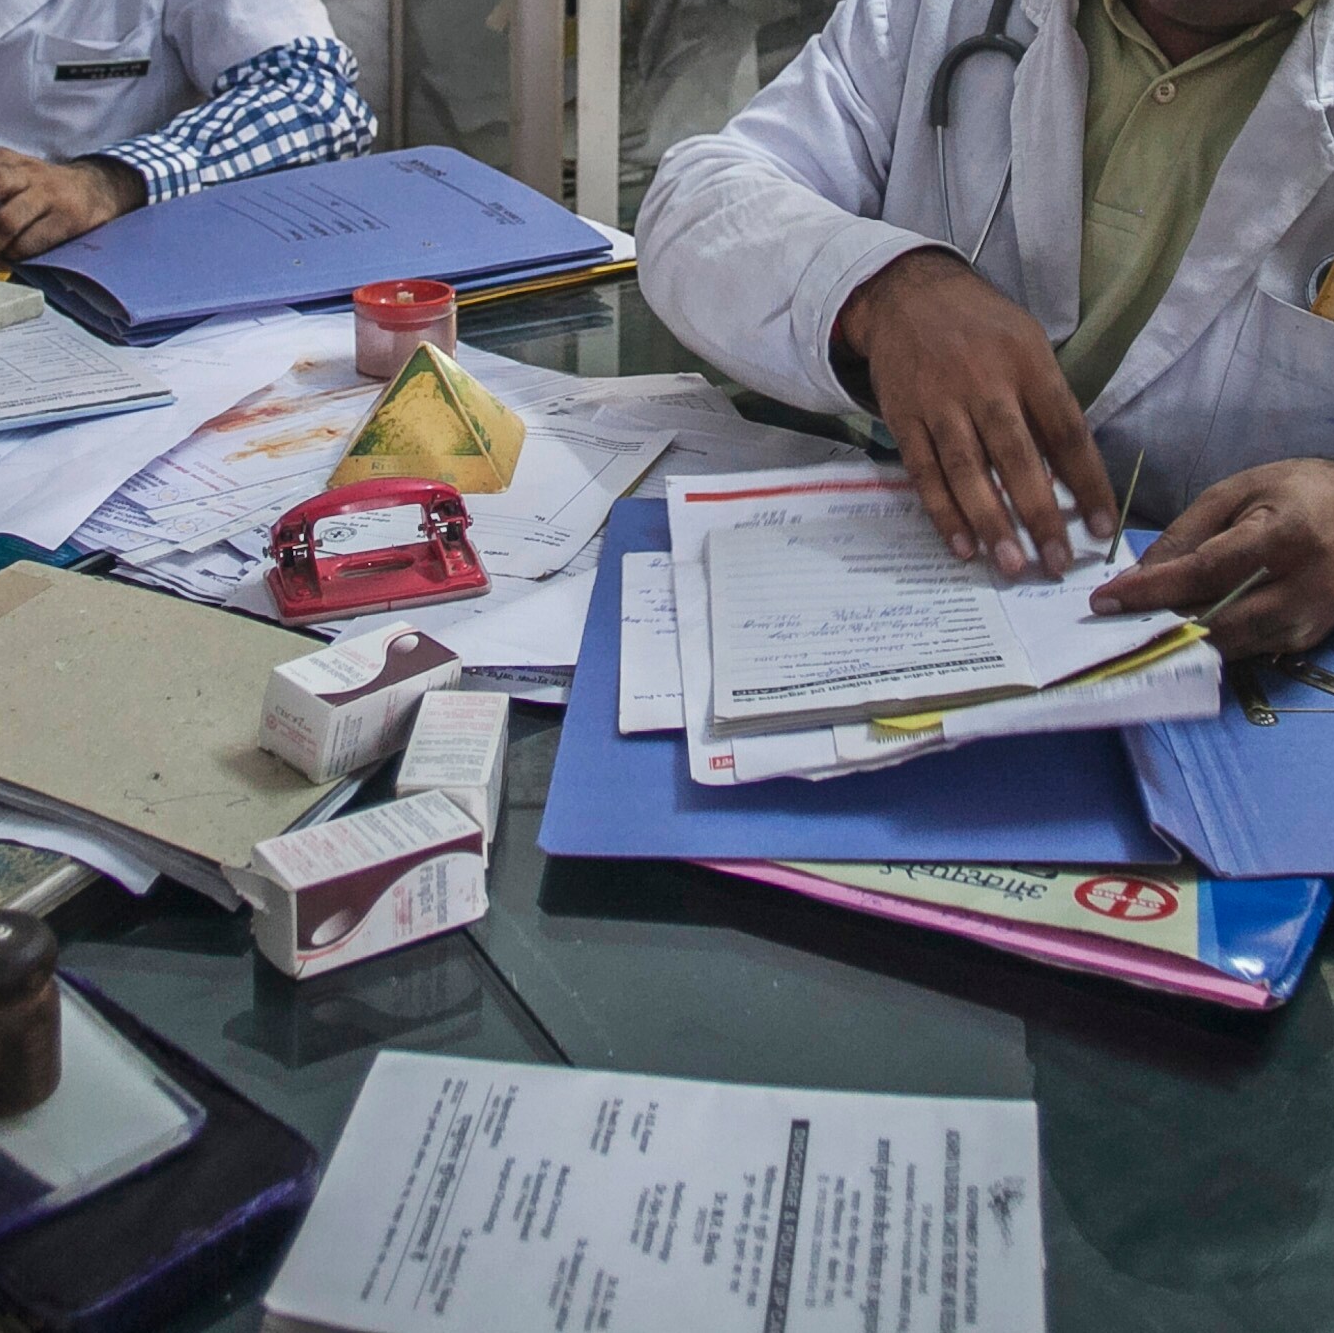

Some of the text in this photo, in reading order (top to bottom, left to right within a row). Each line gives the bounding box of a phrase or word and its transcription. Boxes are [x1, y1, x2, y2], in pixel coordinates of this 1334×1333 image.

[784, 1127, 806, 1209] DISCHARGE
[775, 1223, 795, 1282] FOLLOW
[773, 1286, 790, 1306] UP
